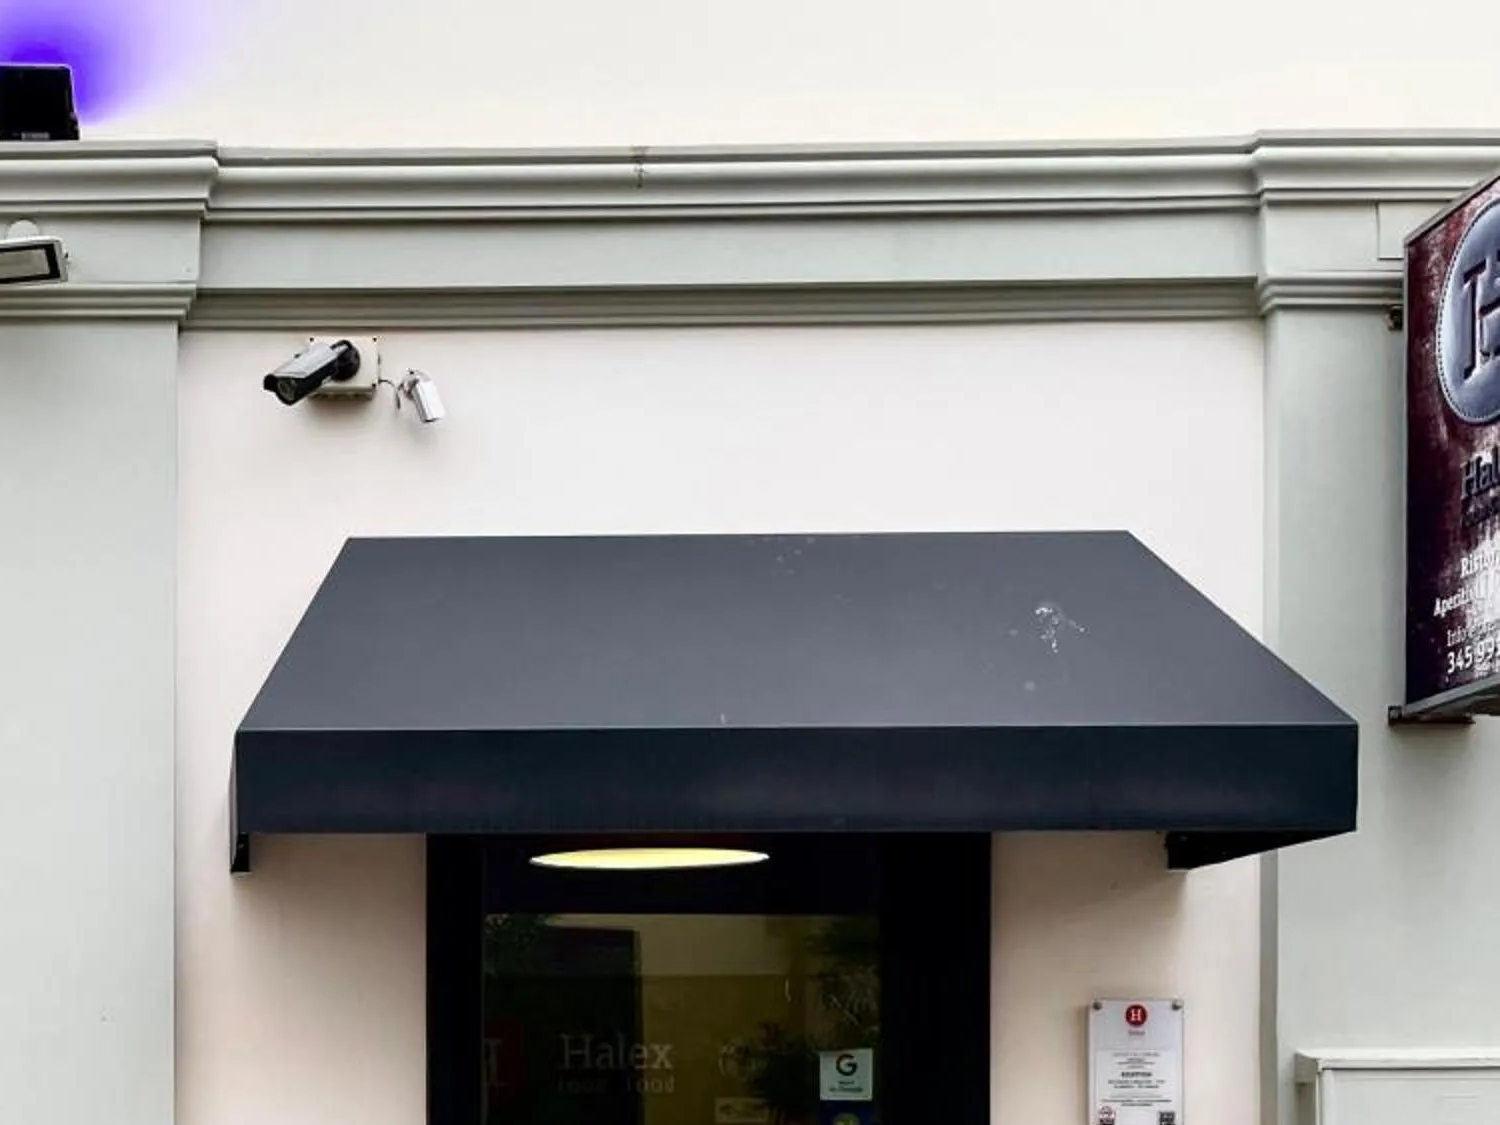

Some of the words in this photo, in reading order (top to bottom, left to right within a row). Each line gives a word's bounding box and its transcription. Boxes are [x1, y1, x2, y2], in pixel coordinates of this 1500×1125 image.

[1447, 645, 1473, 674] 345
[1130, 1009, 1141, 1021] H
[556, 1030, 674, 1070] Halex
[835, 1054, 858, 1077] G
